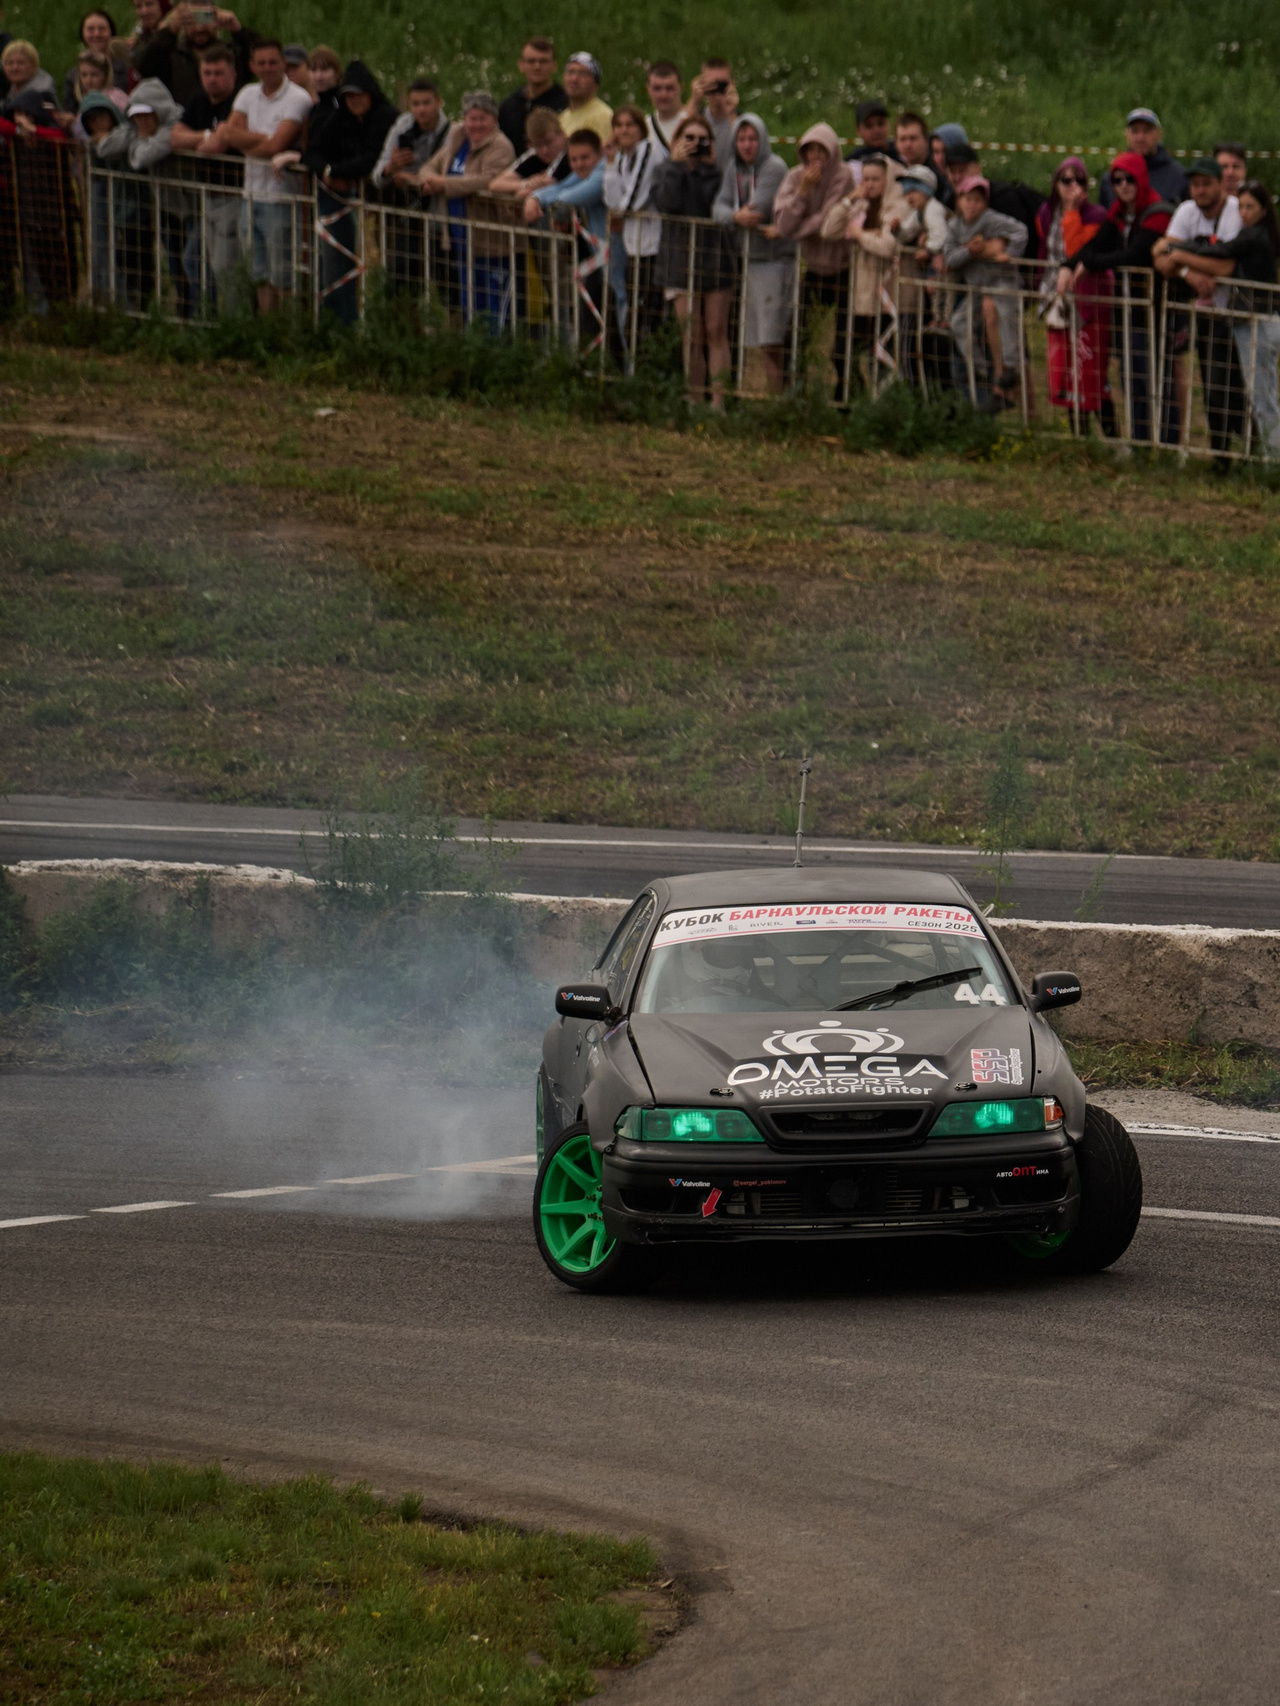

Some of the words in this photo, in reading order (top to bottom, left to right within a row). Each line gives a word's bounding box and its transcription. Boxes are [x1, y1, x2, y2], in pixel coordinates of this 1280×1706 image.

[660, 913, 724, 932] КУБОК
[729, 904, 887, 921] БАРНАУЛЬСКОЙ
[894, 906, 973, 922] РАКЕТЫ
[908, 920, 942, 928] СЕЗОН
[945, 922, 977, 933] 2025
[954, 983, 1007, 1006] 44
[1058, 986, 1080, 994] Valvoline
[727, 1055, 949, 1086] OMEGA
[775, 1077, 905, 1088] MOTORS
[759, 1084, 932, 1099] #PotatoFighter
